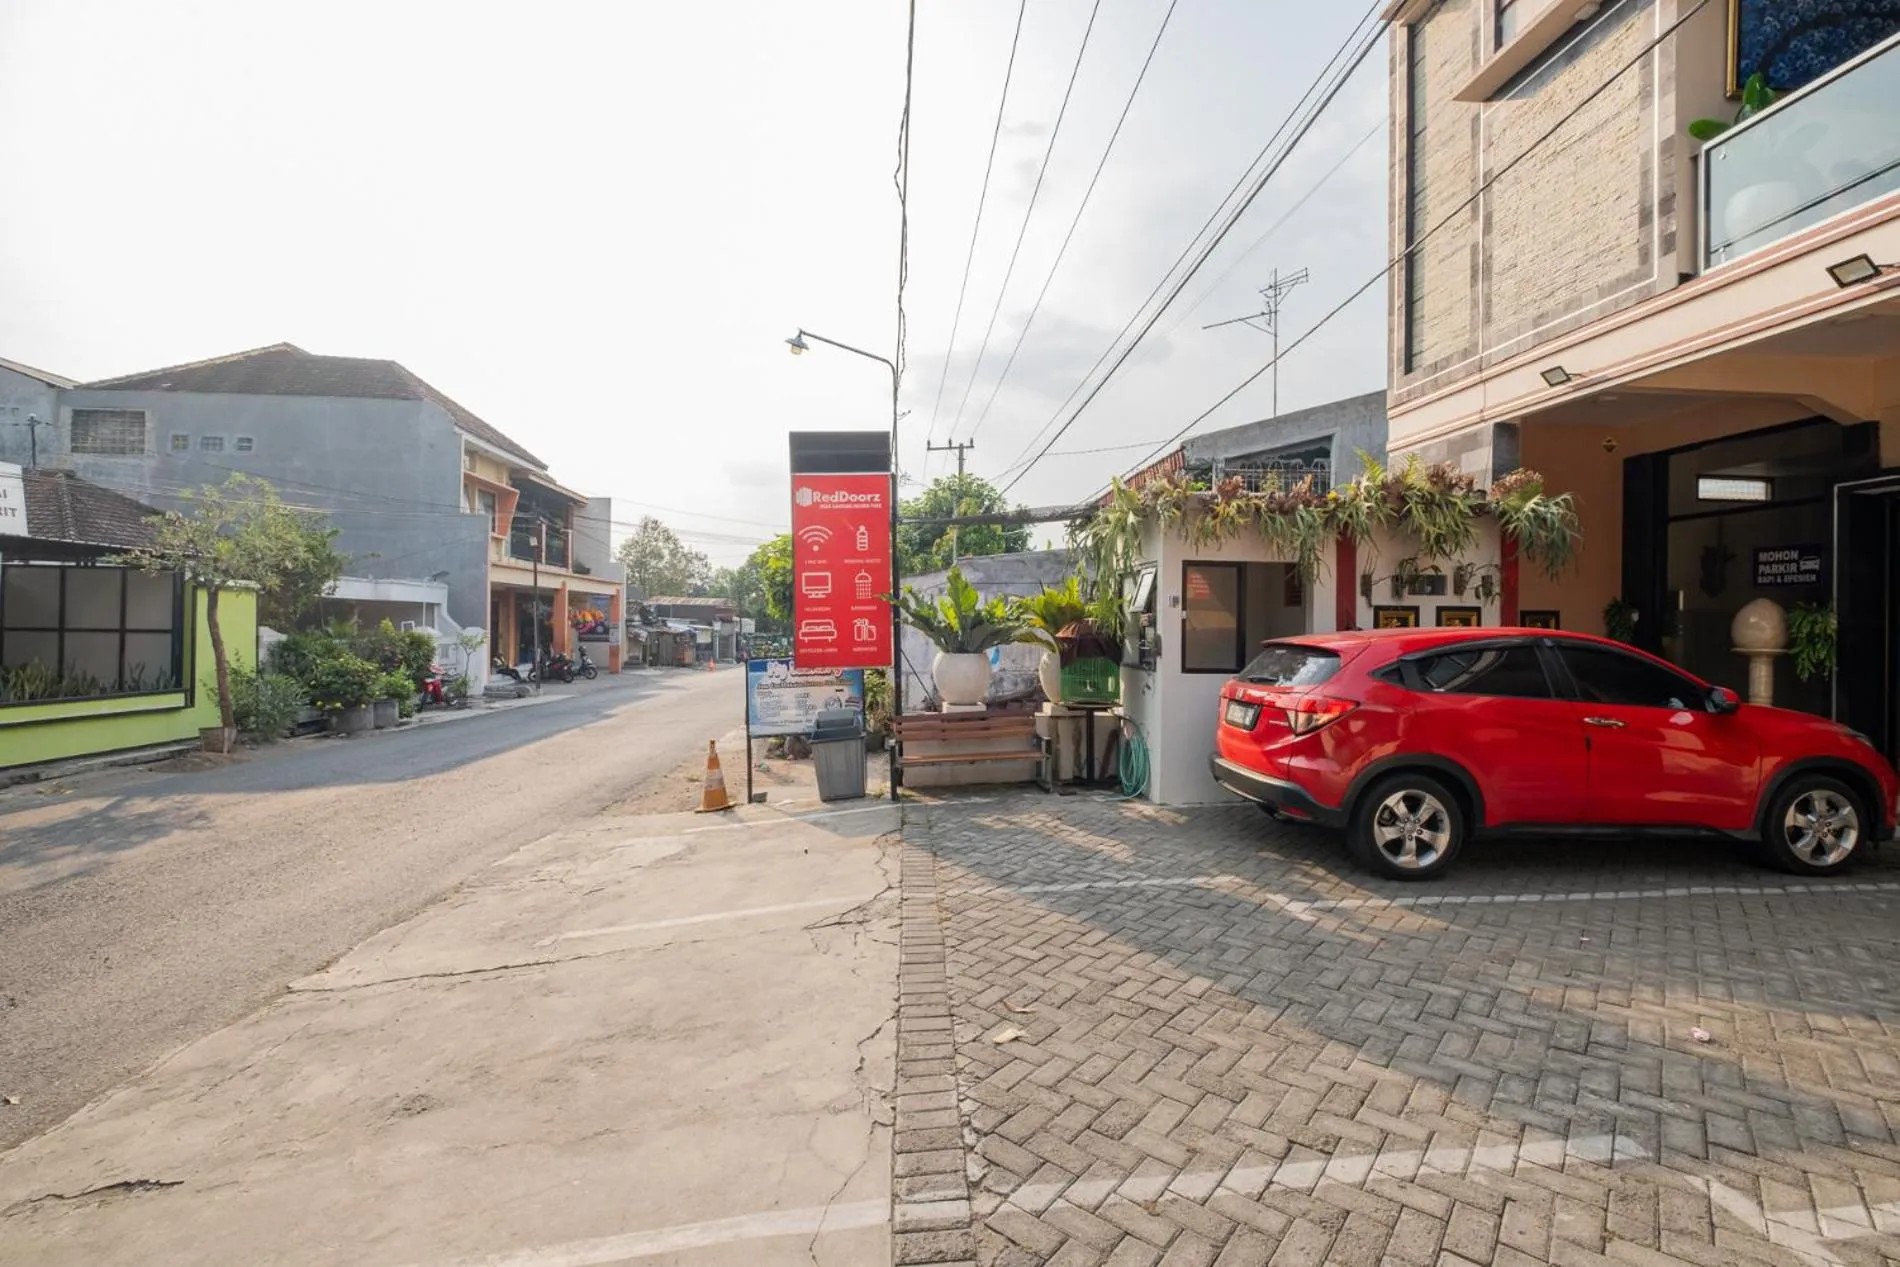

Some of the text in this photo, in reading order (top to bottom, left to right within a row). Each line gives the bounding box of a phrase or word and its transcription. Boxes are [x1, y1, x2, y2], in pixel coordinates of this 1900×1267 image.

[812, 490, 881, 503] RedDoorz
[1758, 549, 1799, 562] MOHON
[1758, 562, 1798, 575] PARKIR
